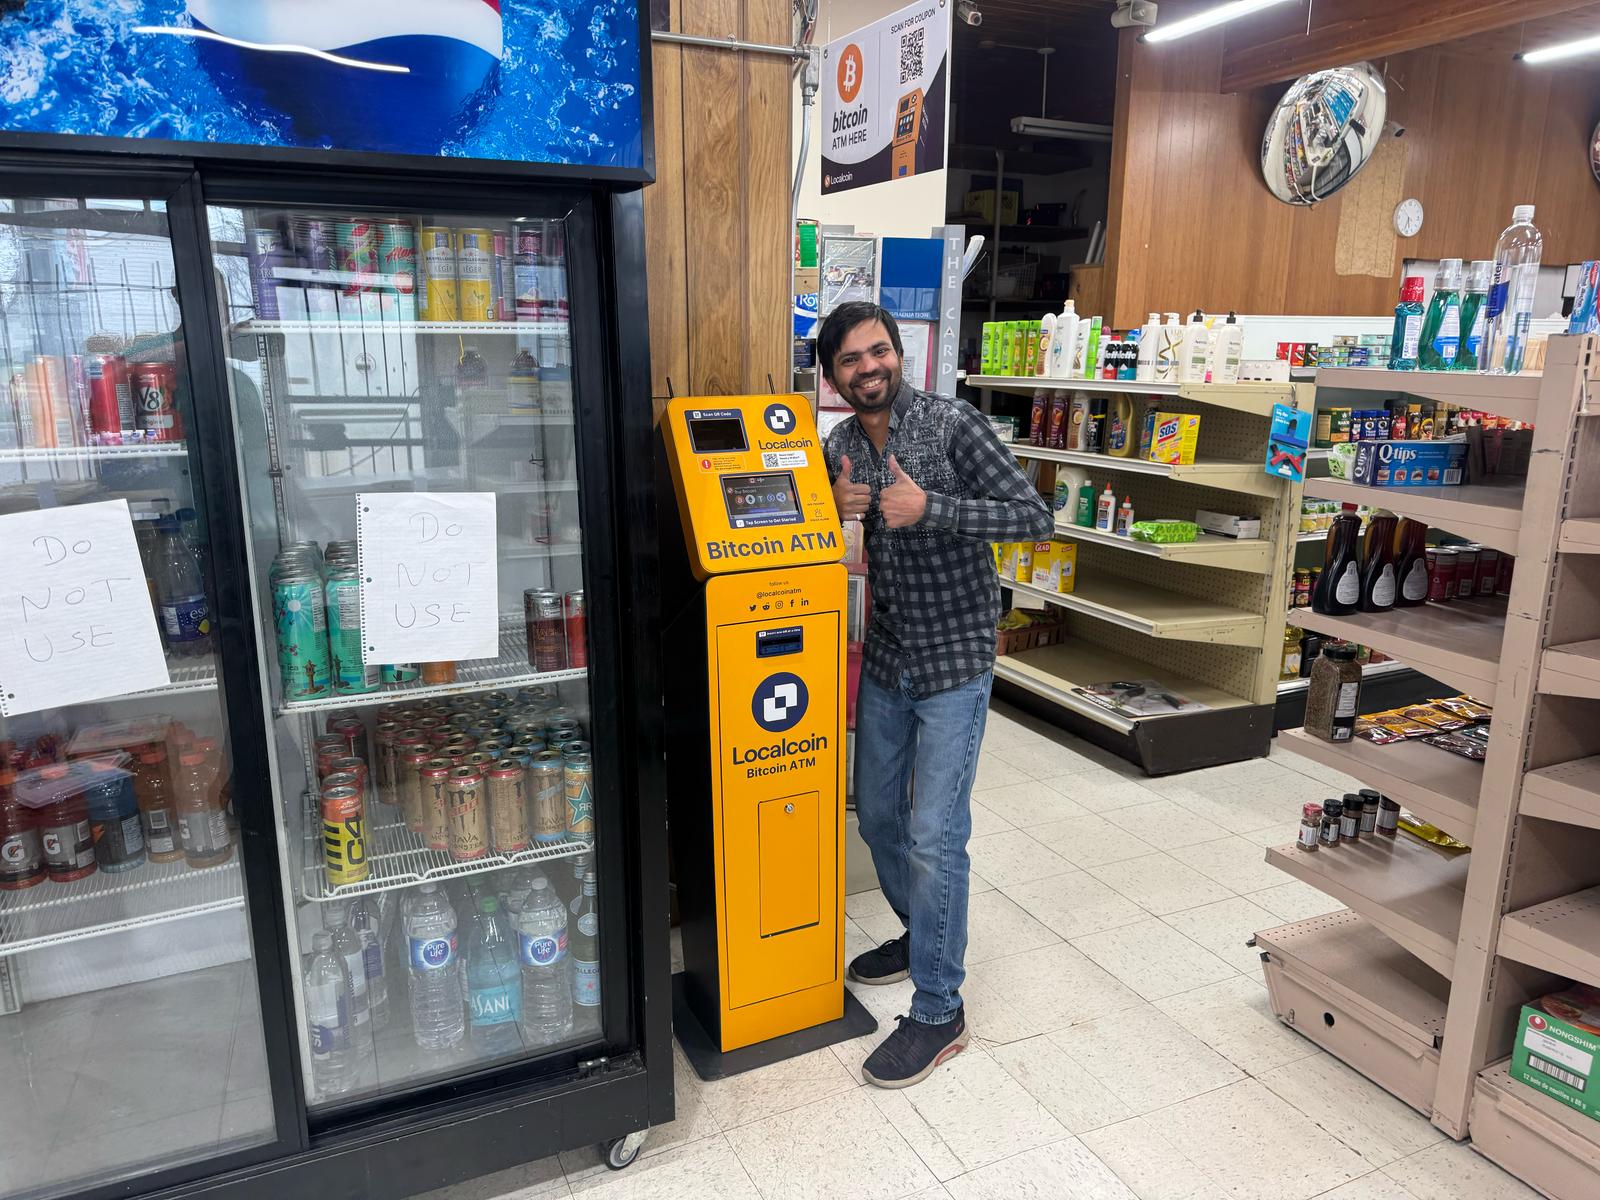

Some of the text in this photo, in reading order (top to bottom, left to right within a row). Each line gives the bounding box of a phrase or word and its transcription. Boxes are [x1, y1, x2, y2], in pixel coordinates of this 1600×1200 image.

[891, 8, 936, 35] SCAN FOR COUPON
[832, 104, 868, 134] bitcoin
[832, 129, 867, 150] ATM HERE
[830, 171, 853, 186] Localcoin
[942, 237, 960, 376] THE CARD
[139, 384, 160, 410] V8
[758, 437, 813, 451] Localcoin
[707, 531, 837, 560] Bitcoin ATM
[1035, 543, 1050, 552] GLAD
[21, 577, 131, 623] NOT
[757, 588, 801, 599] @localcoinatm
[394, 601, 472, 629] USE
[24, 624, 115, 663] USE
[732, 733, 828, 765] Localcoin
[747, 757, 816, 778] Bitcoin ATM
[427, 942, 445, 952] Pure
[430, 949, 443, 958] Life
[534, 940, 551, 949] Pure
[537, 946, 551, 955] Life
[1549, 1026, 1597, 1051] NONGSHIM
